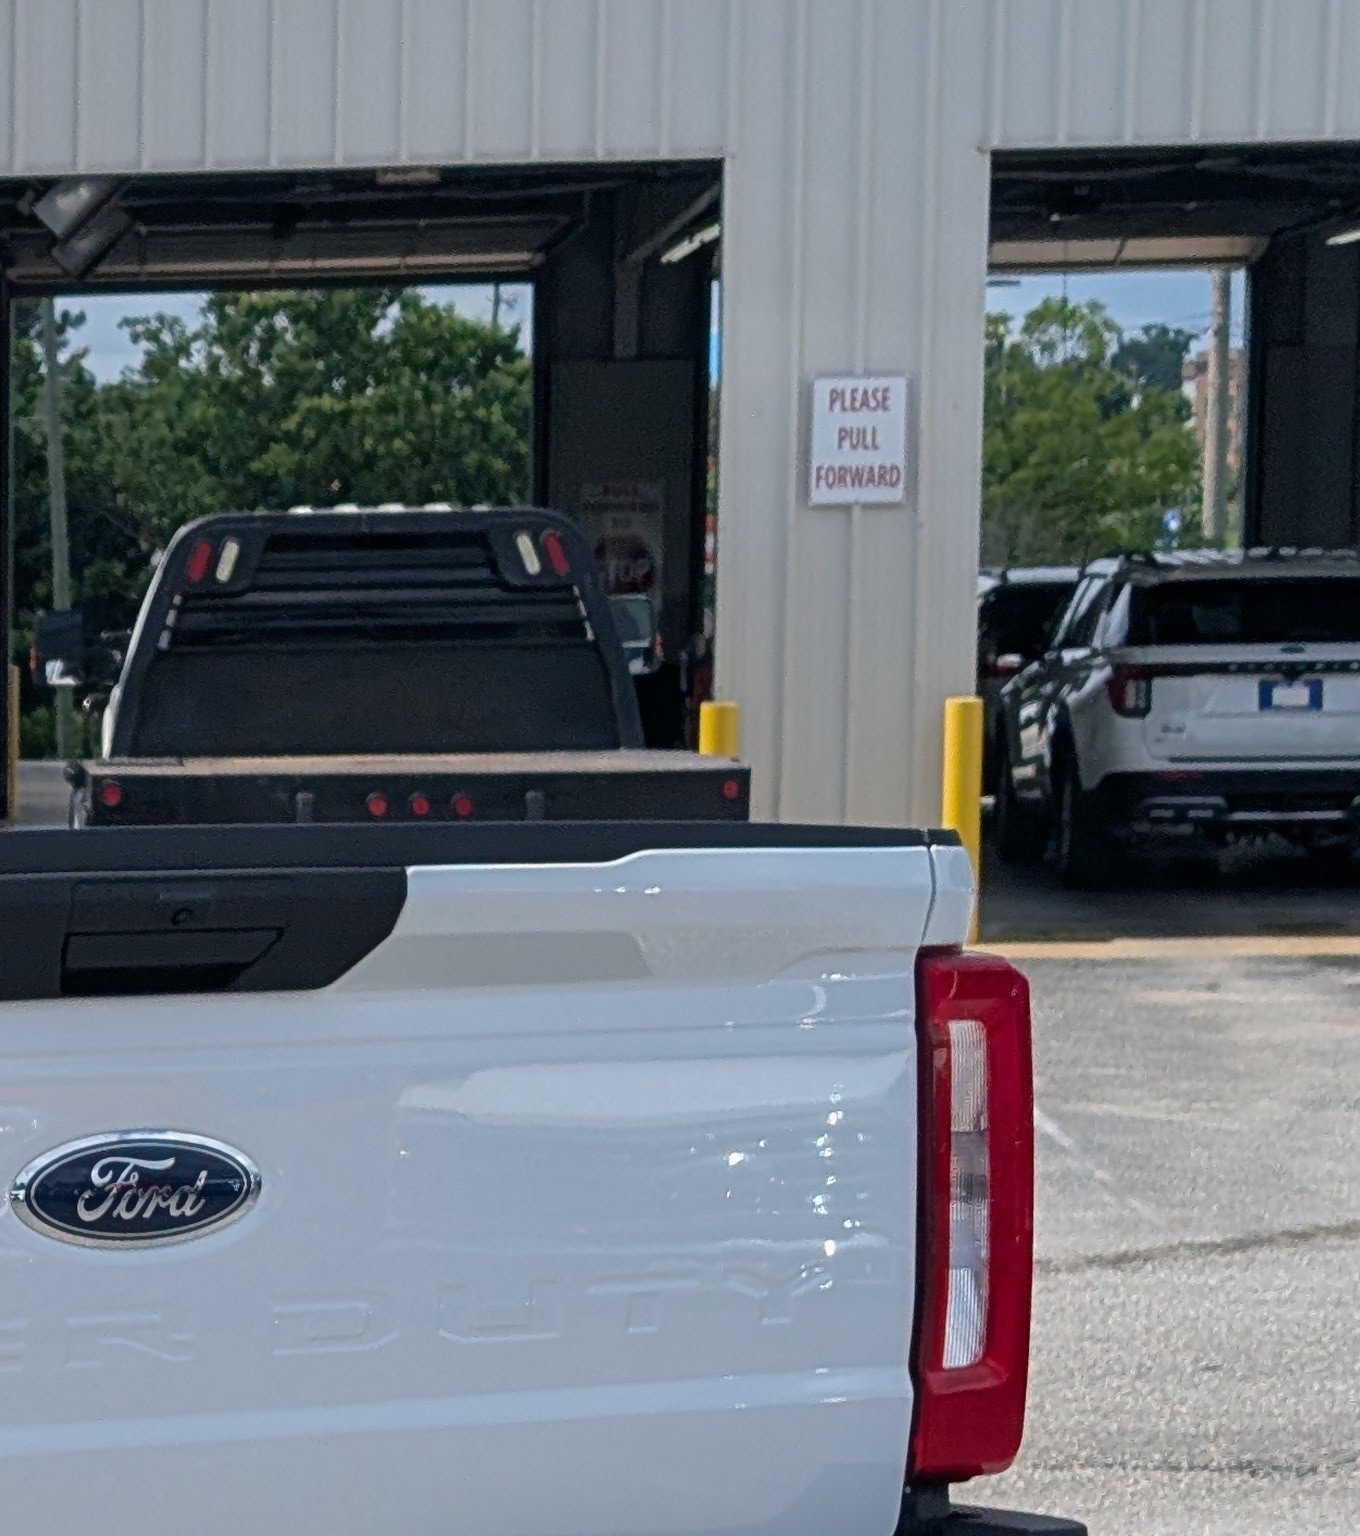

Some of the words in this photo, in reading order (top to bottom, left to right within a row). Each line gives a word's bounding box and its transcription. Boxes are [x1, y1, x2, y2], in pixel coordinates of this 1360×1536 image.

[828, 386, 890, 412] PLEASE
[837, 425, 879, 450] PULL
[815, 463, 901, 490] FORWARD
[76, 1156, 209, 1222] Ford
[270, 1259, 834, 1356] DUTY
